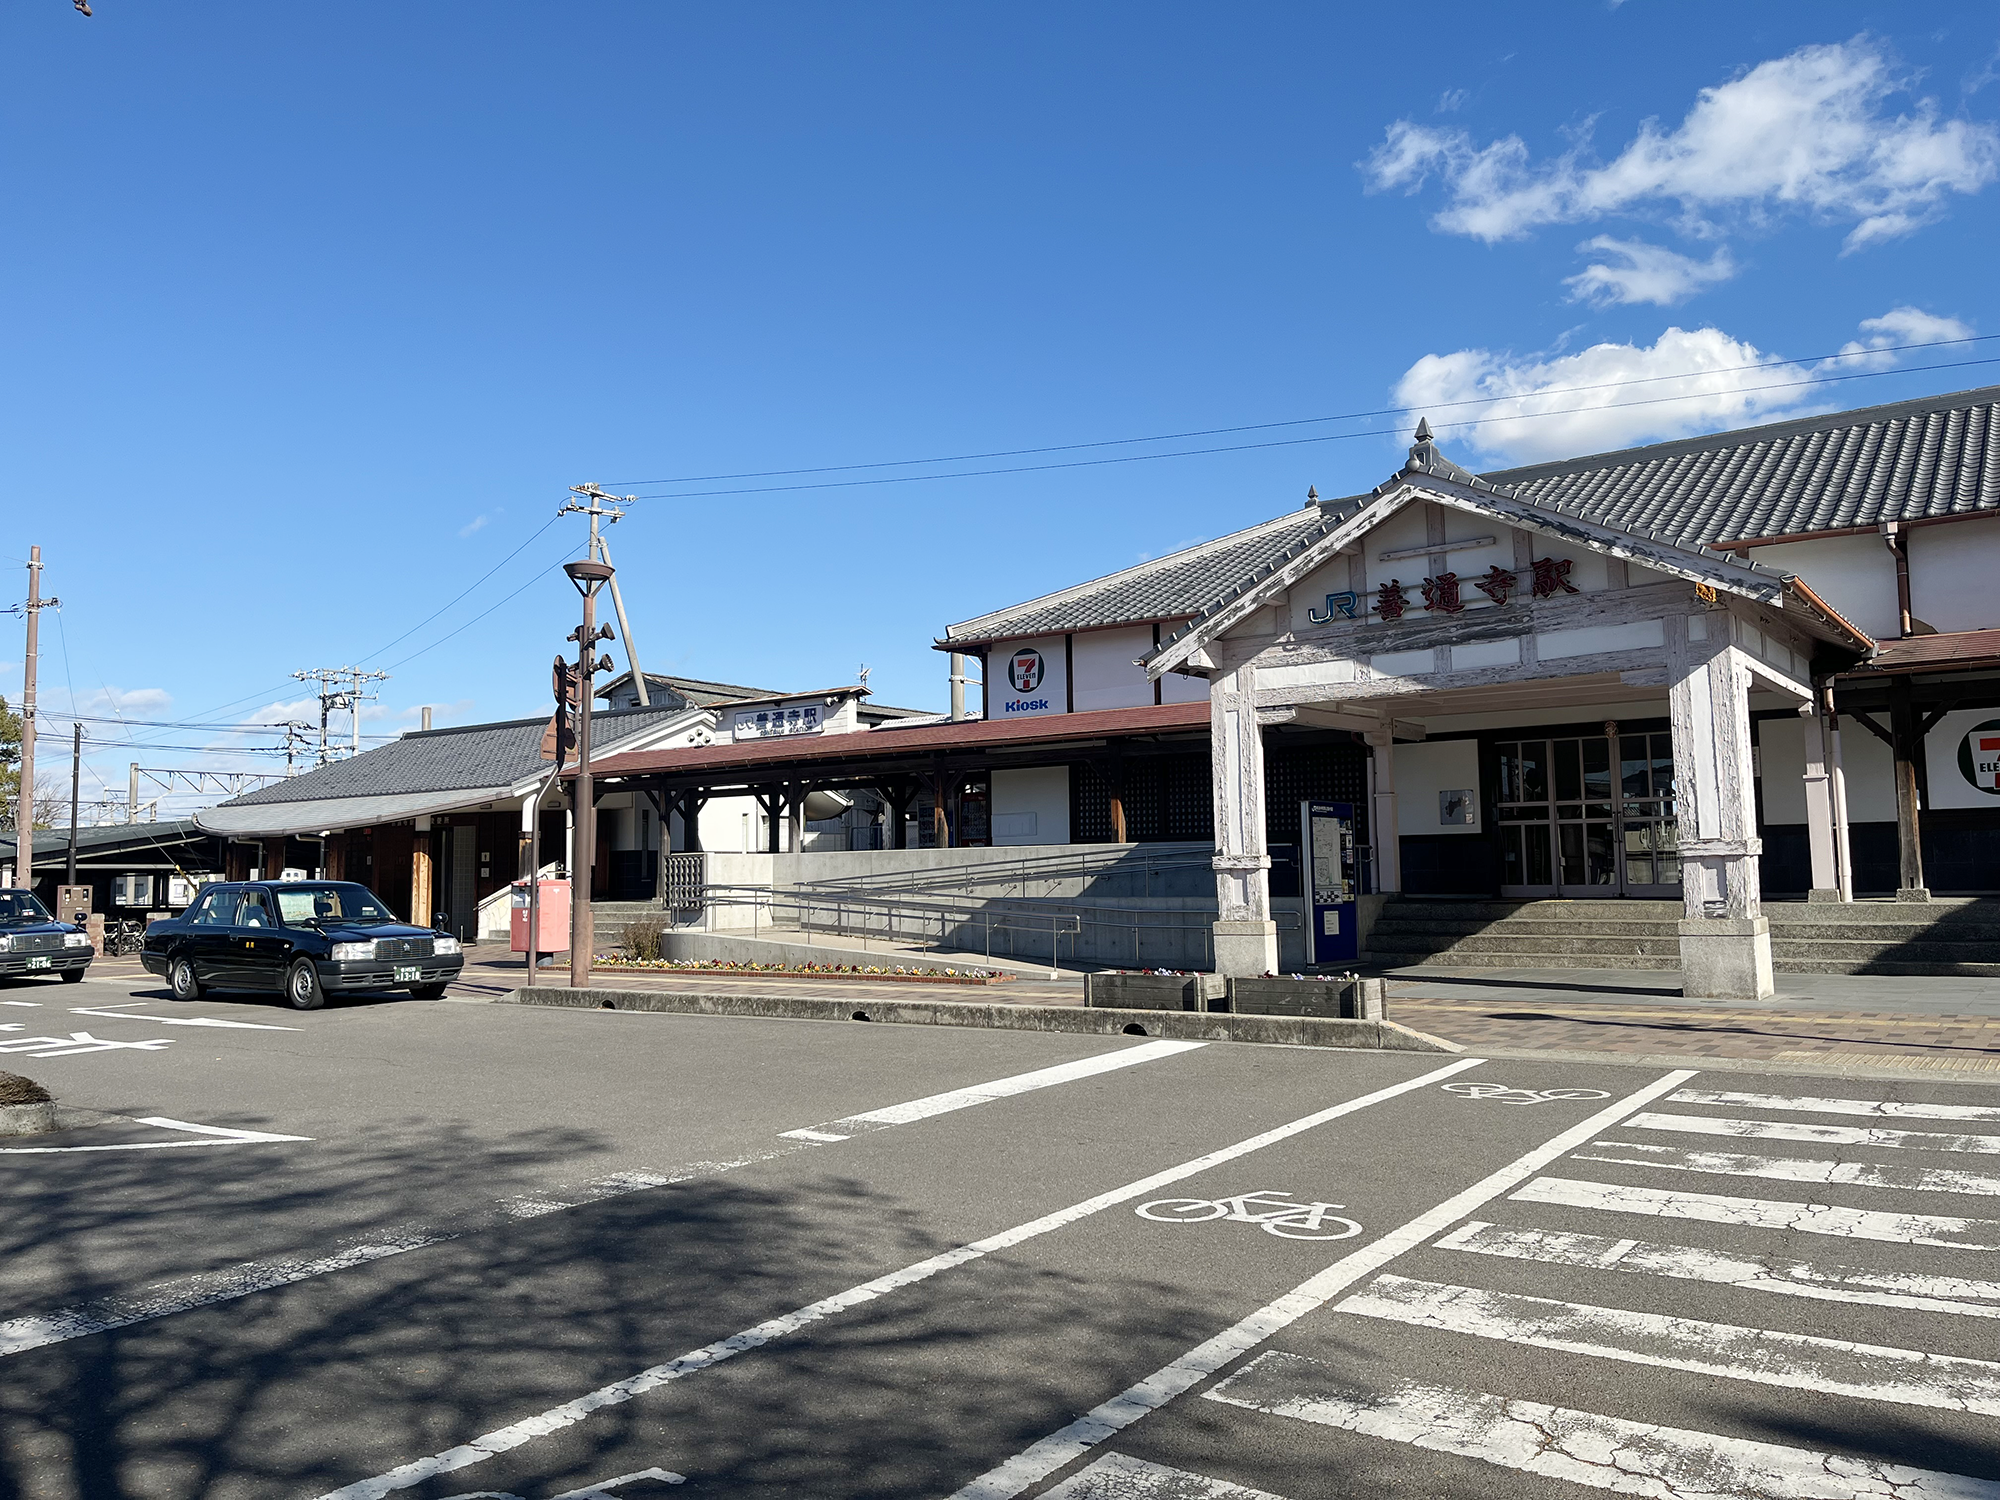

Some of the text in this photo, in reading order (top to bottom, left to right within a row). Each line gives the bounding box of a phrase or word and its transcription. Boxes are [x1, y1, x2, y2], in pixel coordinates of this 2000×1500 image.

[1308, 556, 1581, 625] JR 善通寺駅
[1005, 699, 1049, 712] Kiosk
